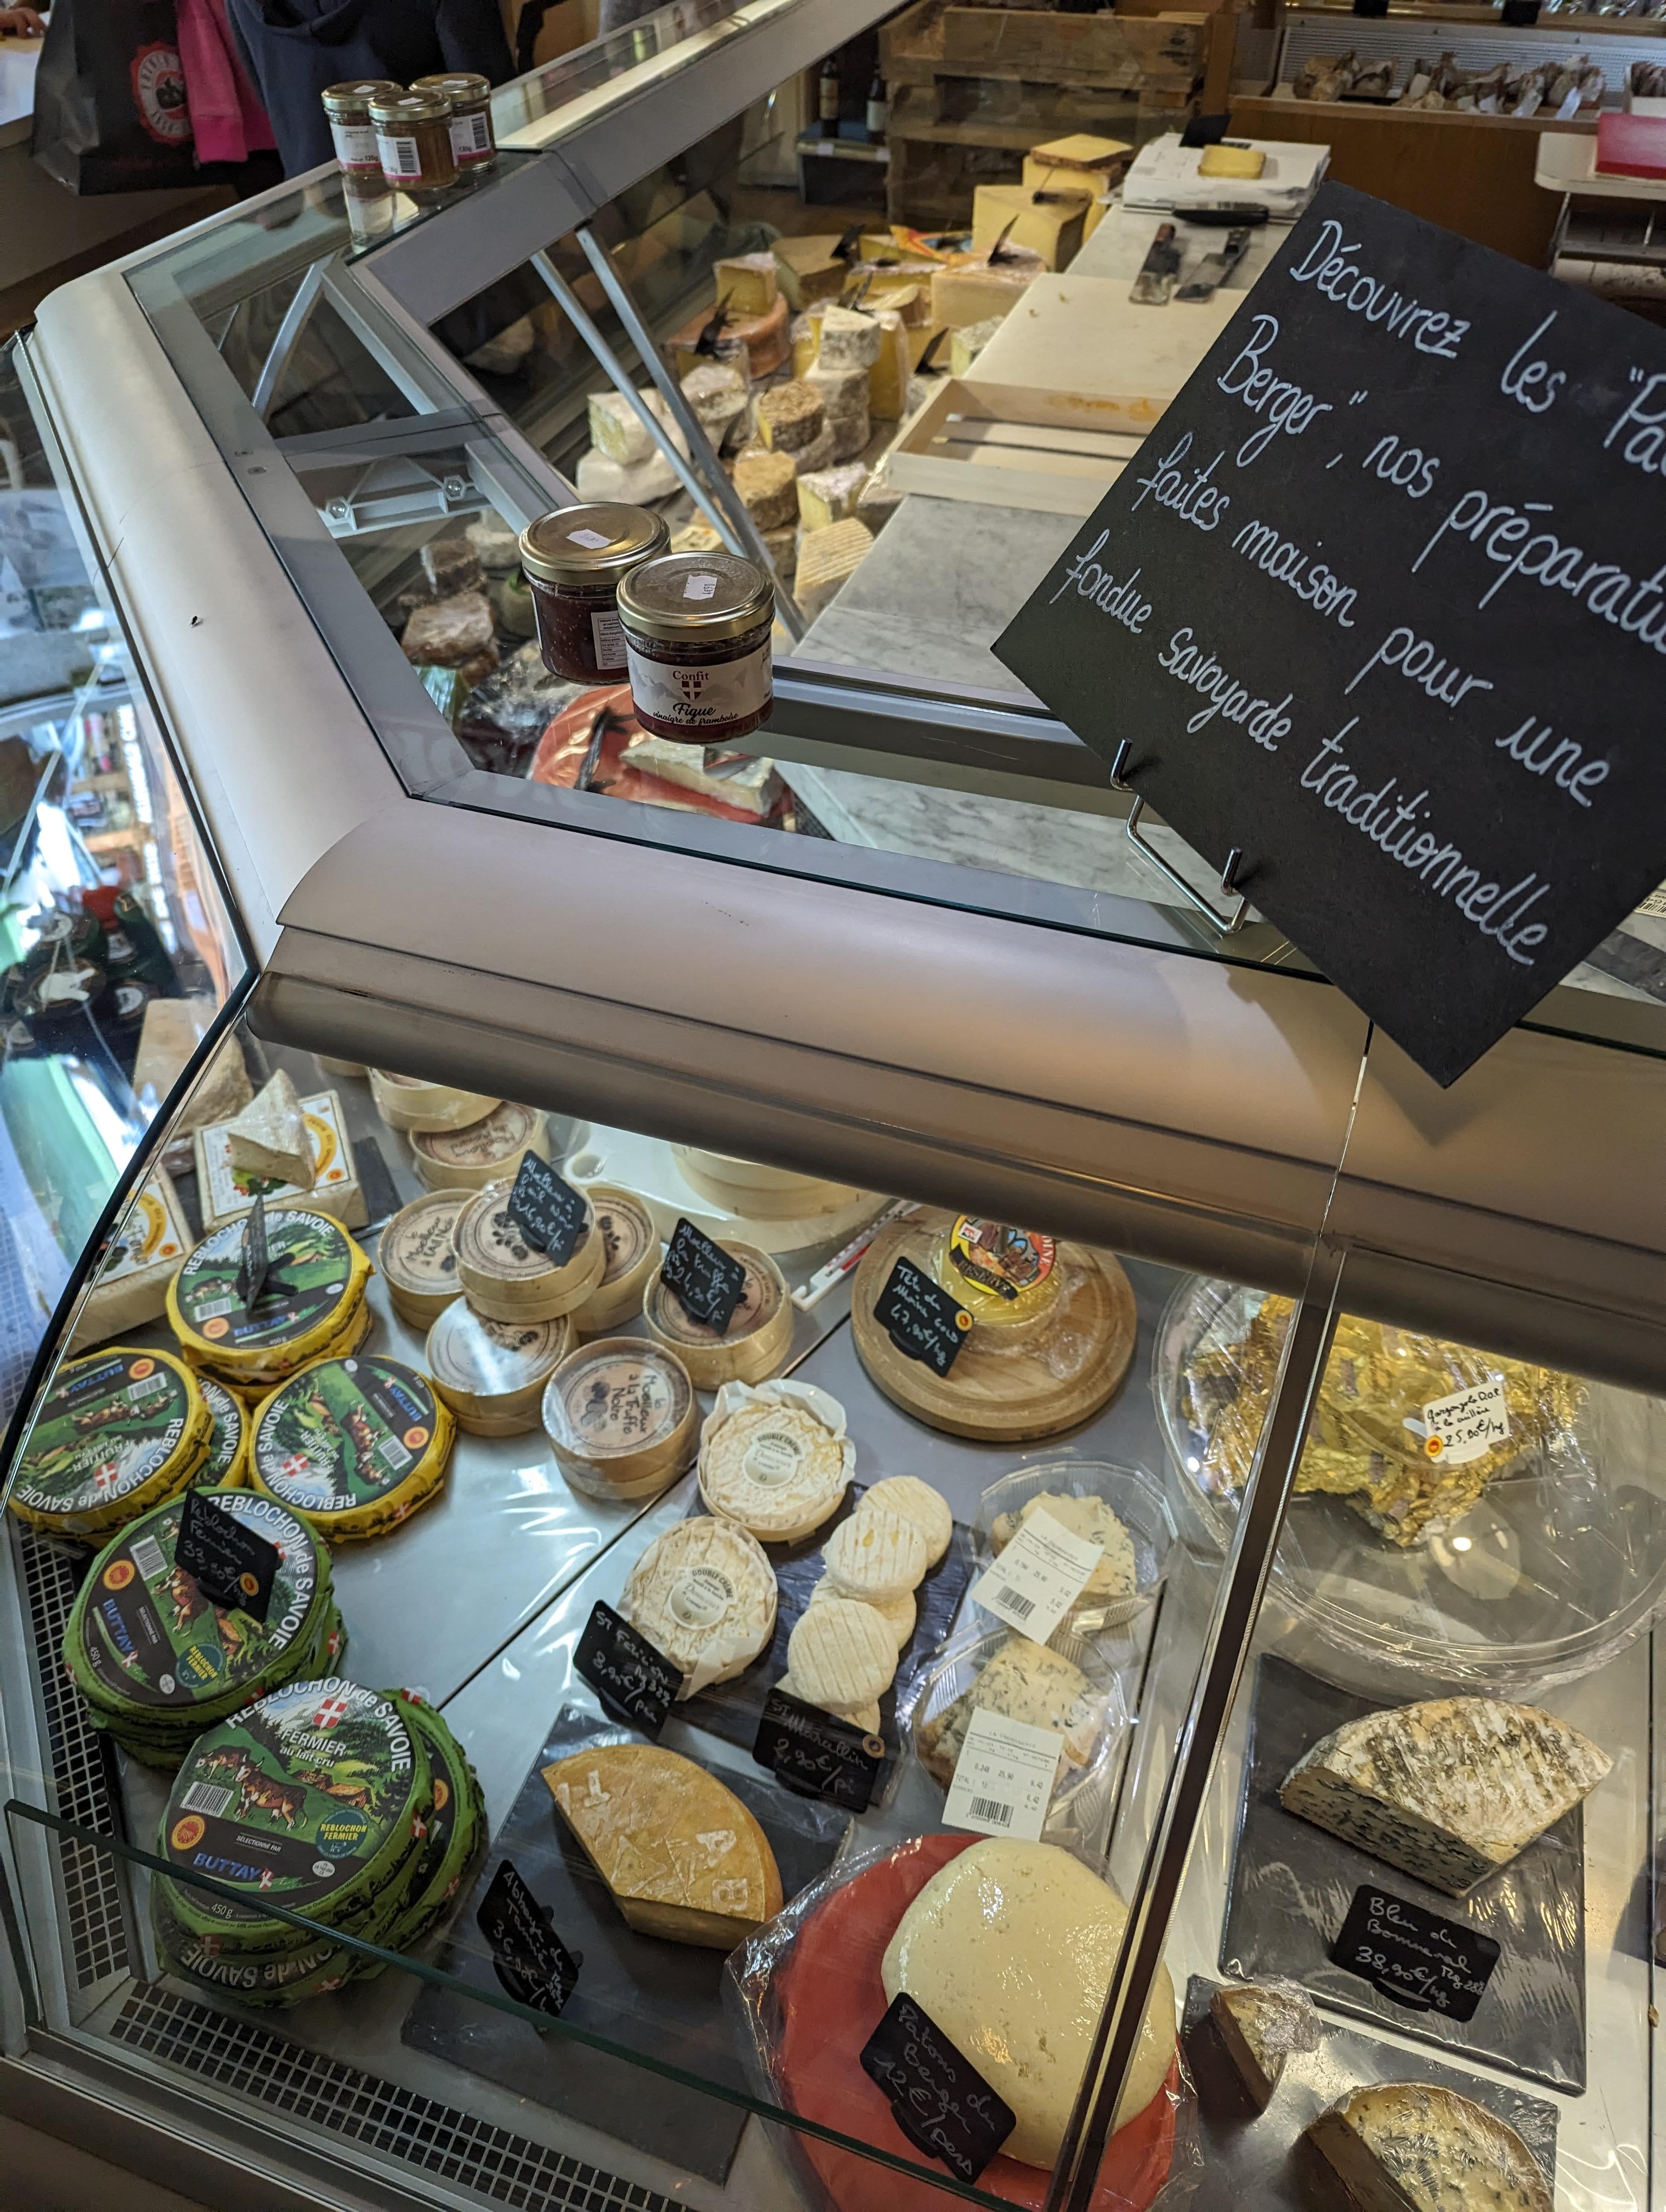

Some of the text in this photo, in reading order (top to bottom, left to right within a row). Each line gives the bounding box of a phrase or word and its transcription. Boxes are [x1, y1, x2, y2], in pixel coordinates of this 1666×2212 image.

[1291, 220, 1471, 358] Découvrez
[1501, 310, 1567, 413] les
[1362, 435, 1440, 498] nos
[1132, 432, 1611, 807] faites maison pour une
[672, 671, 710, 681] Confit
[653, 711, 683, 724] vinaigre
[699, 712, 739, 726] framboise
[672, 703, 716, 721] Figue
[1049, 529, 1549, 966] fondue savoyarde traditionnelle
[183, 1218, 249, 1276] REBLOCHO
[285, 1211, 336, 1237] SAVOIE
[234, 1315, 287, 1337] BUTTAY
[69, 1364, 124, 1394] BUTTAY
[388, 1386, 423, 1422] BUTTAY
[216, 1394, 240, 1464] de SAVOIE
[16, 1417, 184, 1513] REBLOCHON de SAVOIE
[258, 1399, 356, 1511] REBLOCHON de SAVOIE
[295, 1551, 313, 1573] de
[691, 1569, 720, 1579] DOUBLE
[102, 1598, 136, 1652] BUTTAY
[269, 1574, 314, 1651] SAVOIE
[89, 1646, 101, 1661] 450
[186, 1656, 208, 1681] FERMIER
[189, 1644, 219, 1680] REBLOCHON
[280, 1727, 347, 1757] FERMIER
[356, 1689, 378, 1708] de
[374, 1700, 411, 1772] SAVOIE
[279, 1746, 335, 1768] au lait cru
[320, 1823, 368, 1832] REBLOCHON
[323, 1832, 358, 1841] FERMIER
[270, 1843, 282, 1853] PAR
[193, 1853, 262, 1881] BUTTAY
[212, 1904, 226, 1915] 450
[226, 1908, 233, 1919] g
[180, 1944, 259, 1988] SAVOIE
